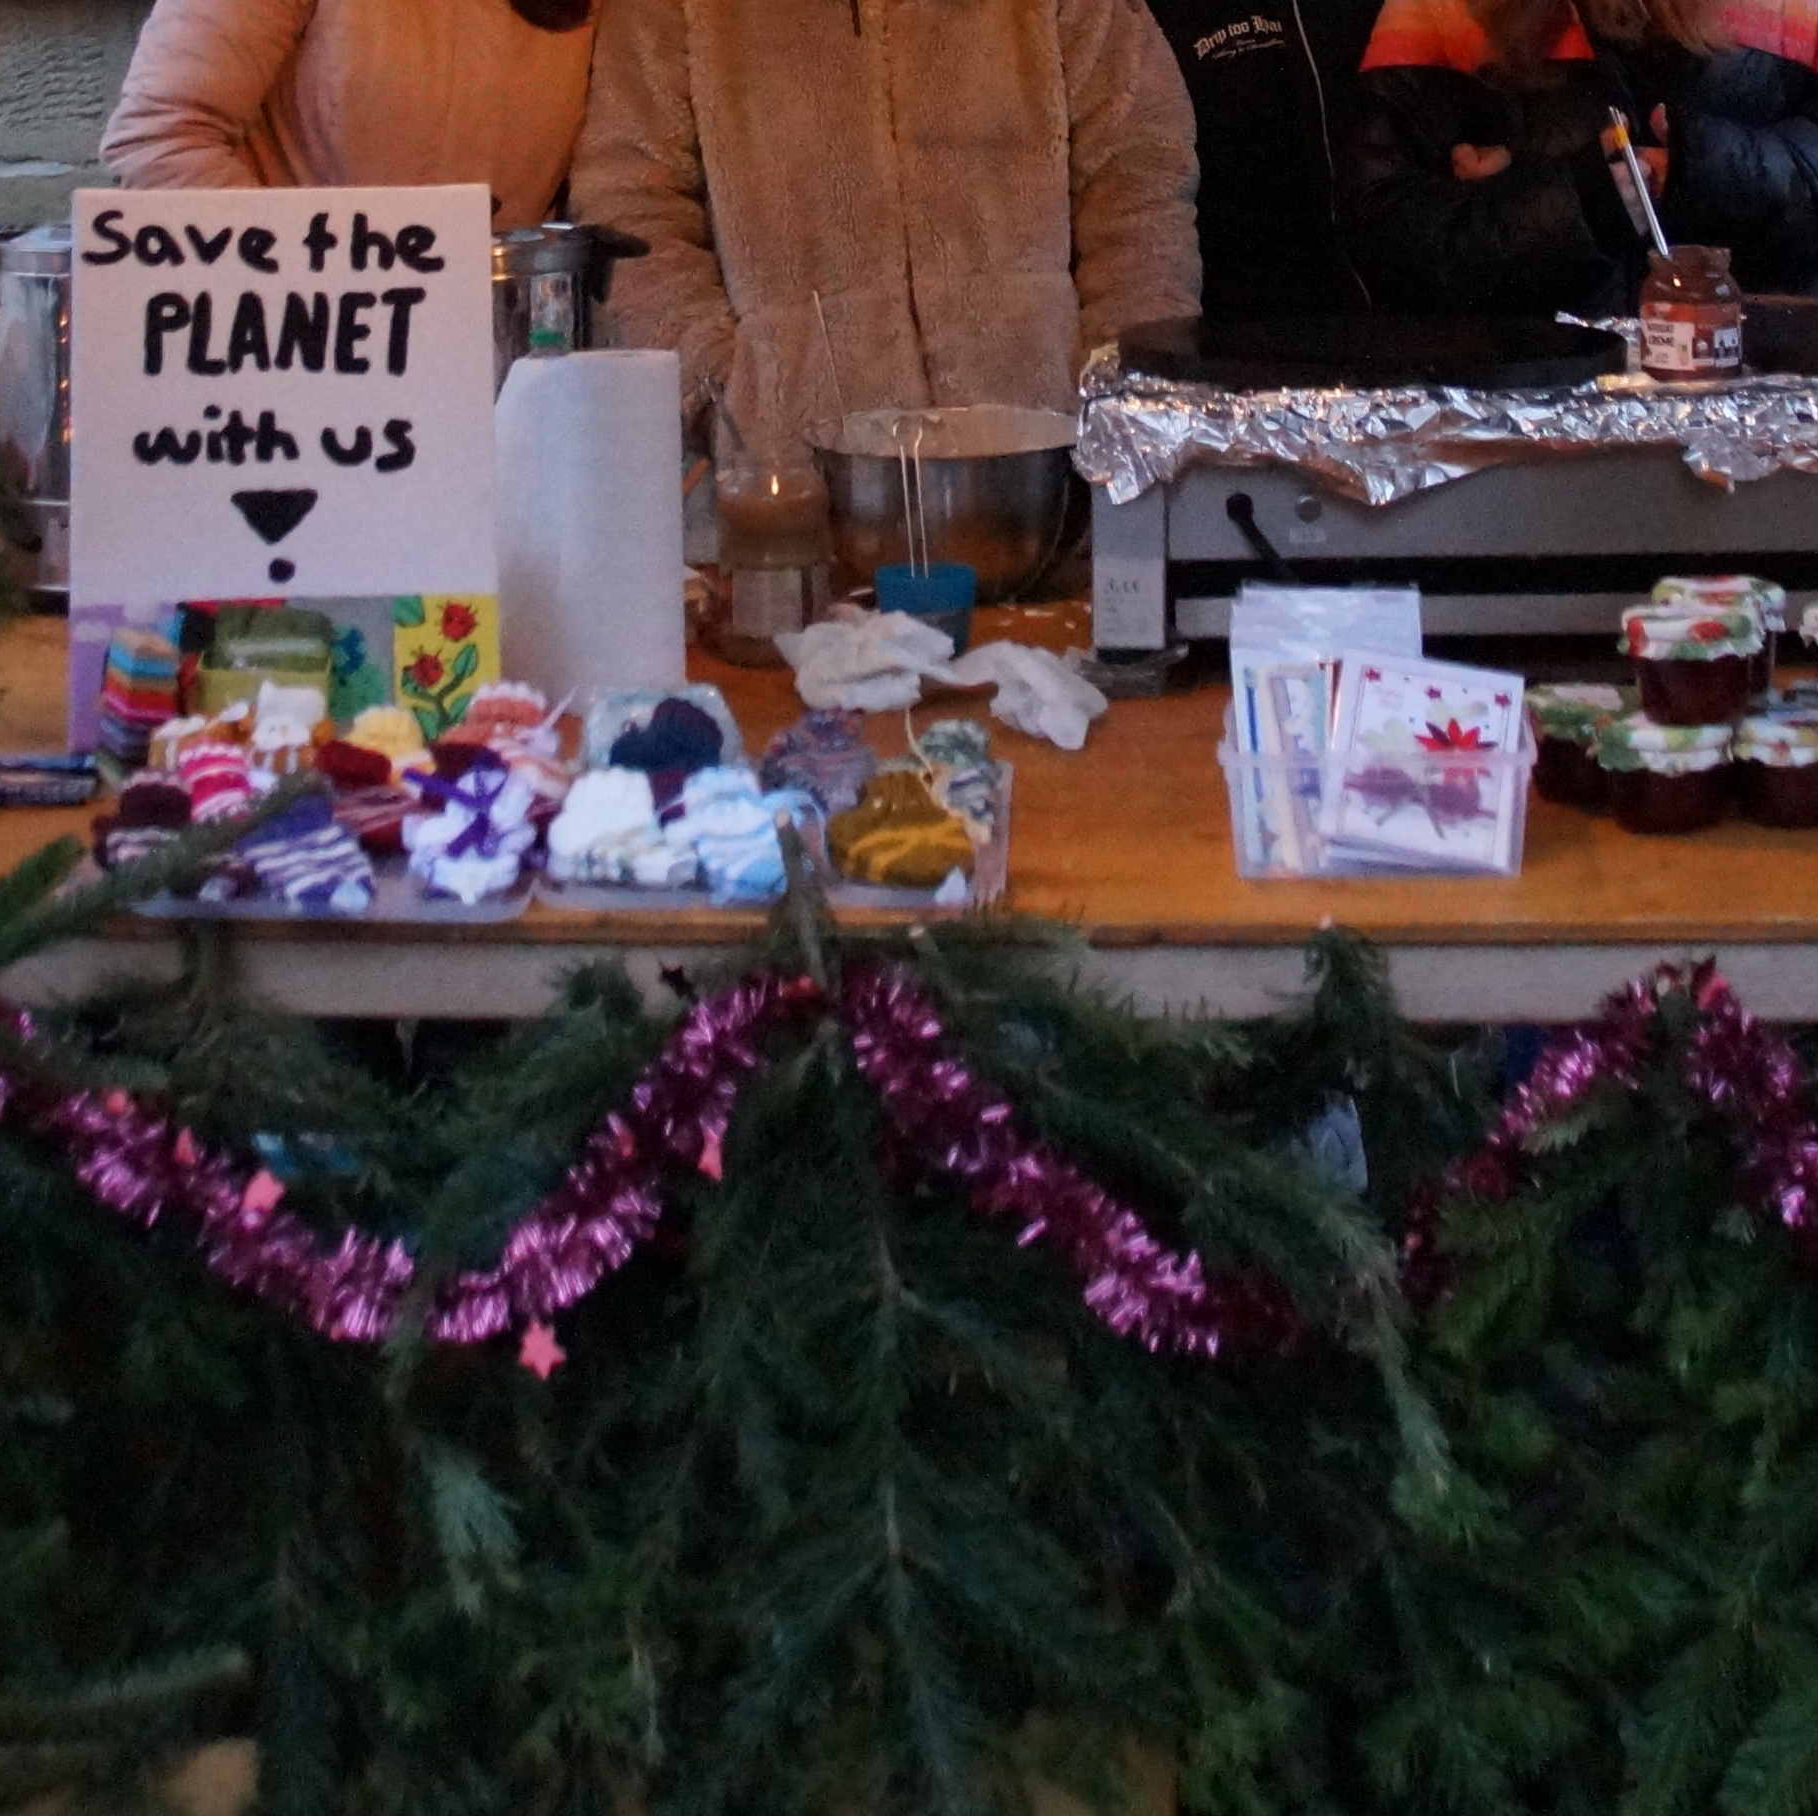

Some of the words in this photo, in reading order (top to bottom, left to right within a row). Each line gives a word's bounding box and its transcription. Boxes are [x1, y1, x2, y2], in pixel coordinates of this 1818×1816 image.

[81, 209, 280, 274] Save
[303, 212, 445, 274] the
[143, 287, 427, 377] PLANET
[132, 404, 300, 466] with
[319, 418, 417, 473] us
